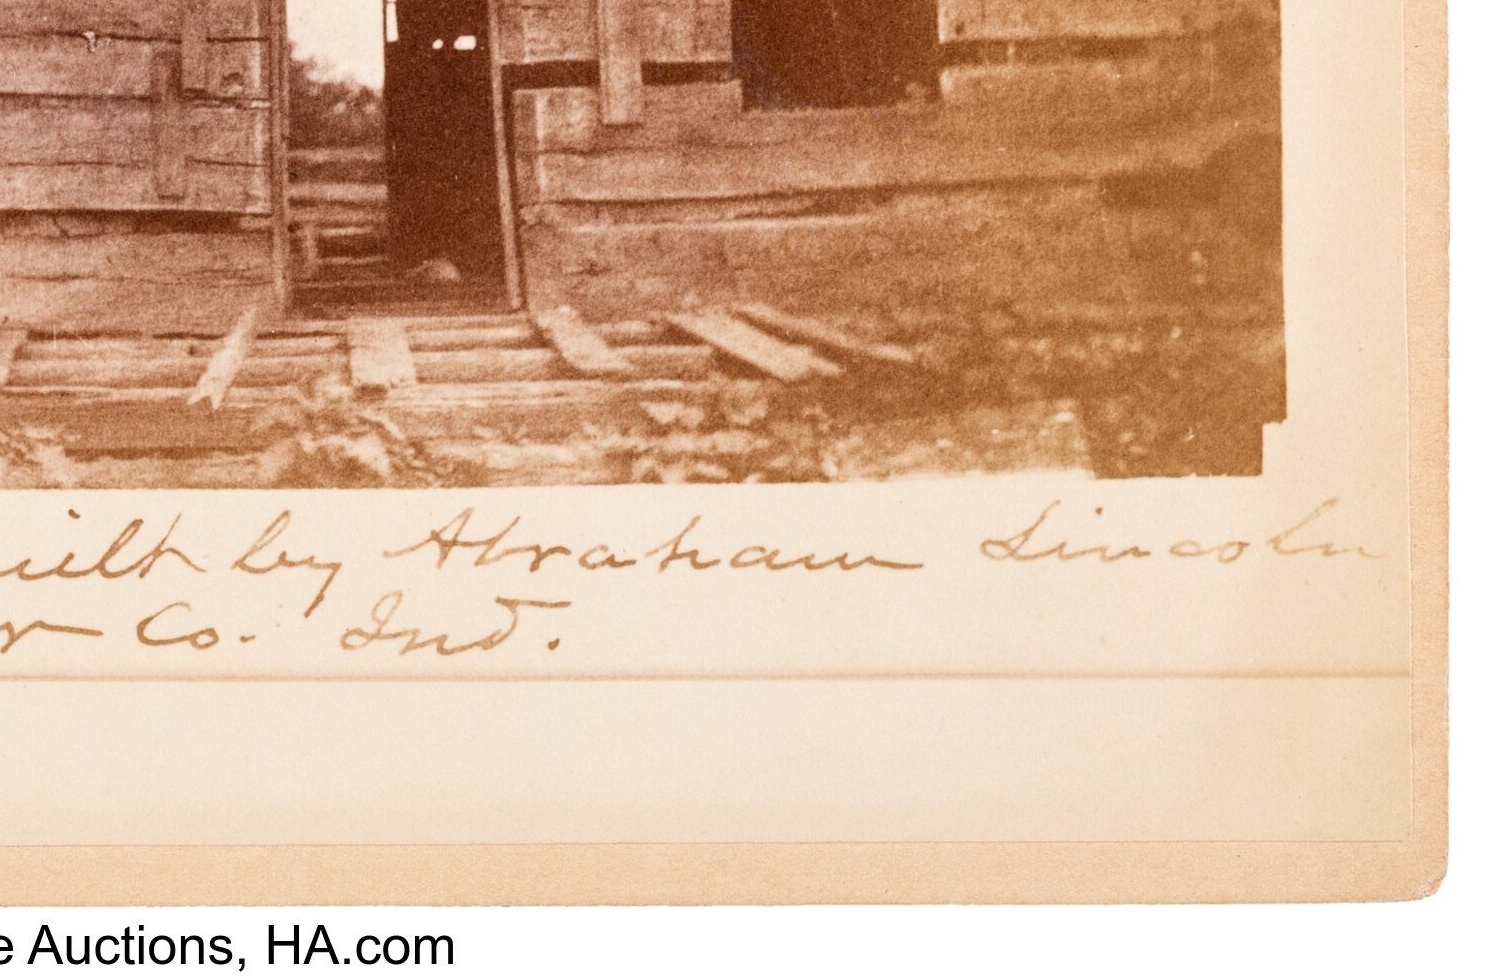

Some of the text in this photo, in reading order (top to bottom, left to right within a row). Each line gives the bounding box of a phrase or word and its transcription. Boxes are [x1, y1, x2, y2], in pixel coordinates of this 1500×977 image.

[230, 509, 343, 620] by
[382, 507, 926, 574] Abraham
[979, 497, 1389, 565] Lincoln
[135, 600, 257, 652] Co.
